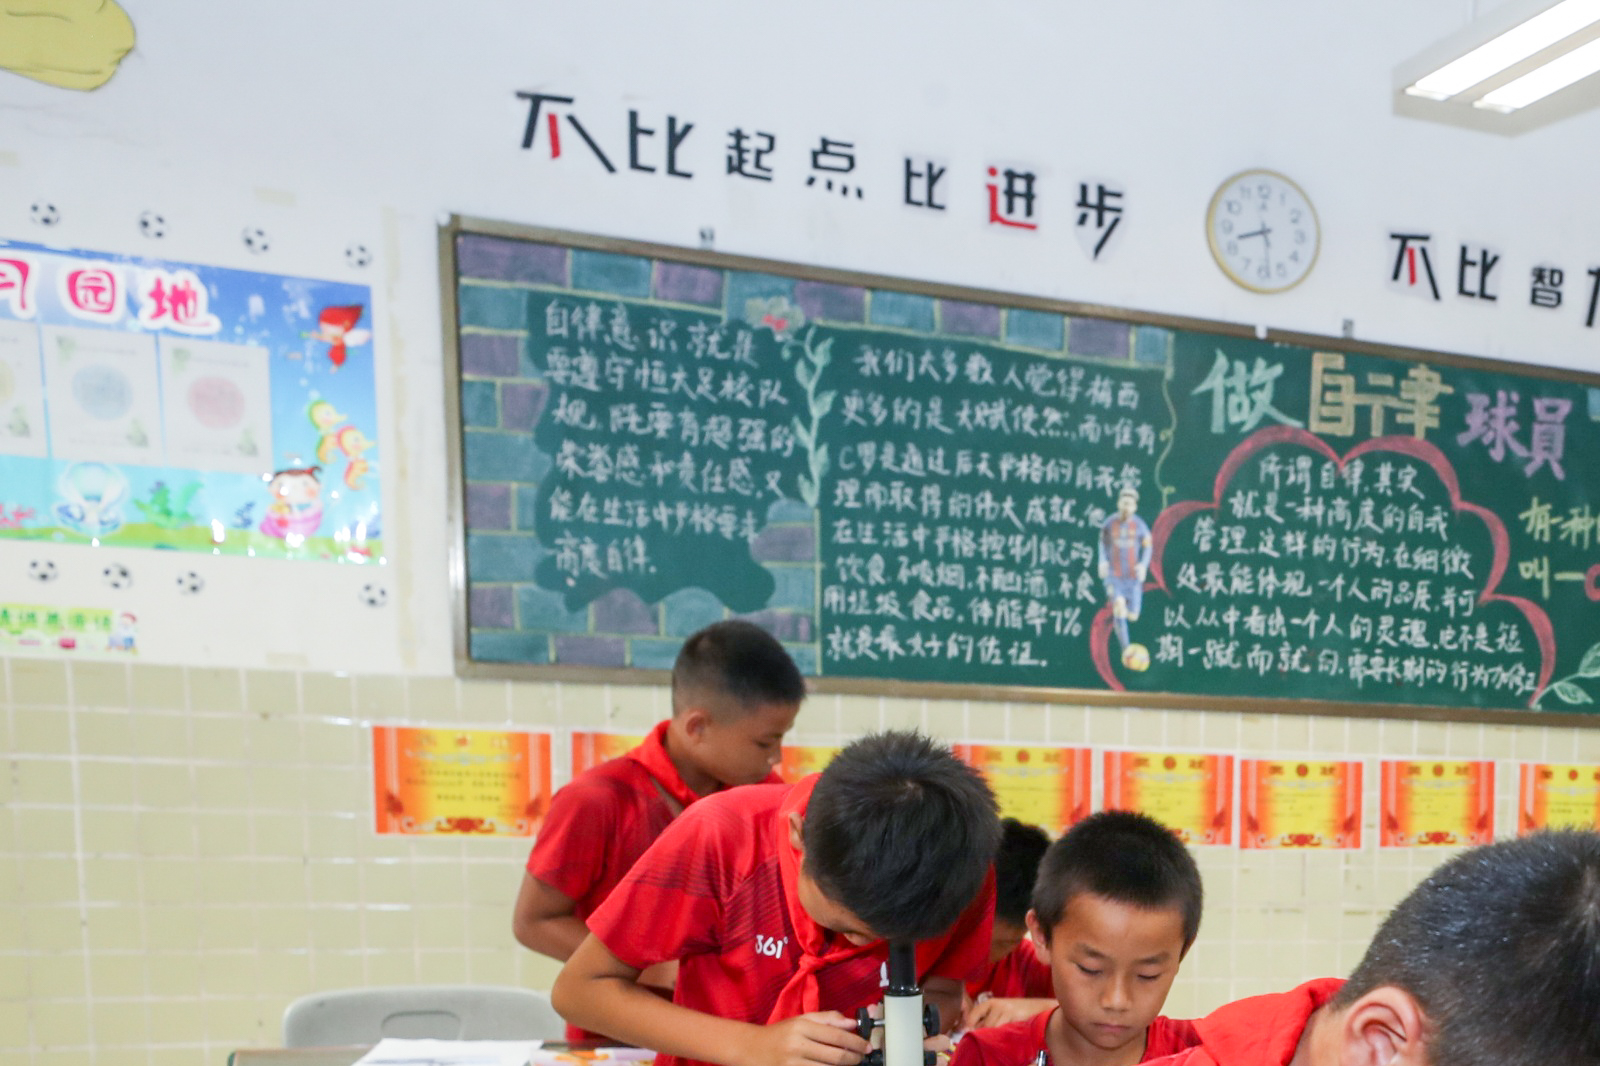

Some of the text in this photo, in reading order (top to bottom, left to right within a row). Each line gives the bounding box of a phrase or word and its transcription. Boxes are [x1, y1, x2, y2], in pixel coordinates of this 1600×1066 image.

[515, 89, 1125, 260] 不比起点比进步
